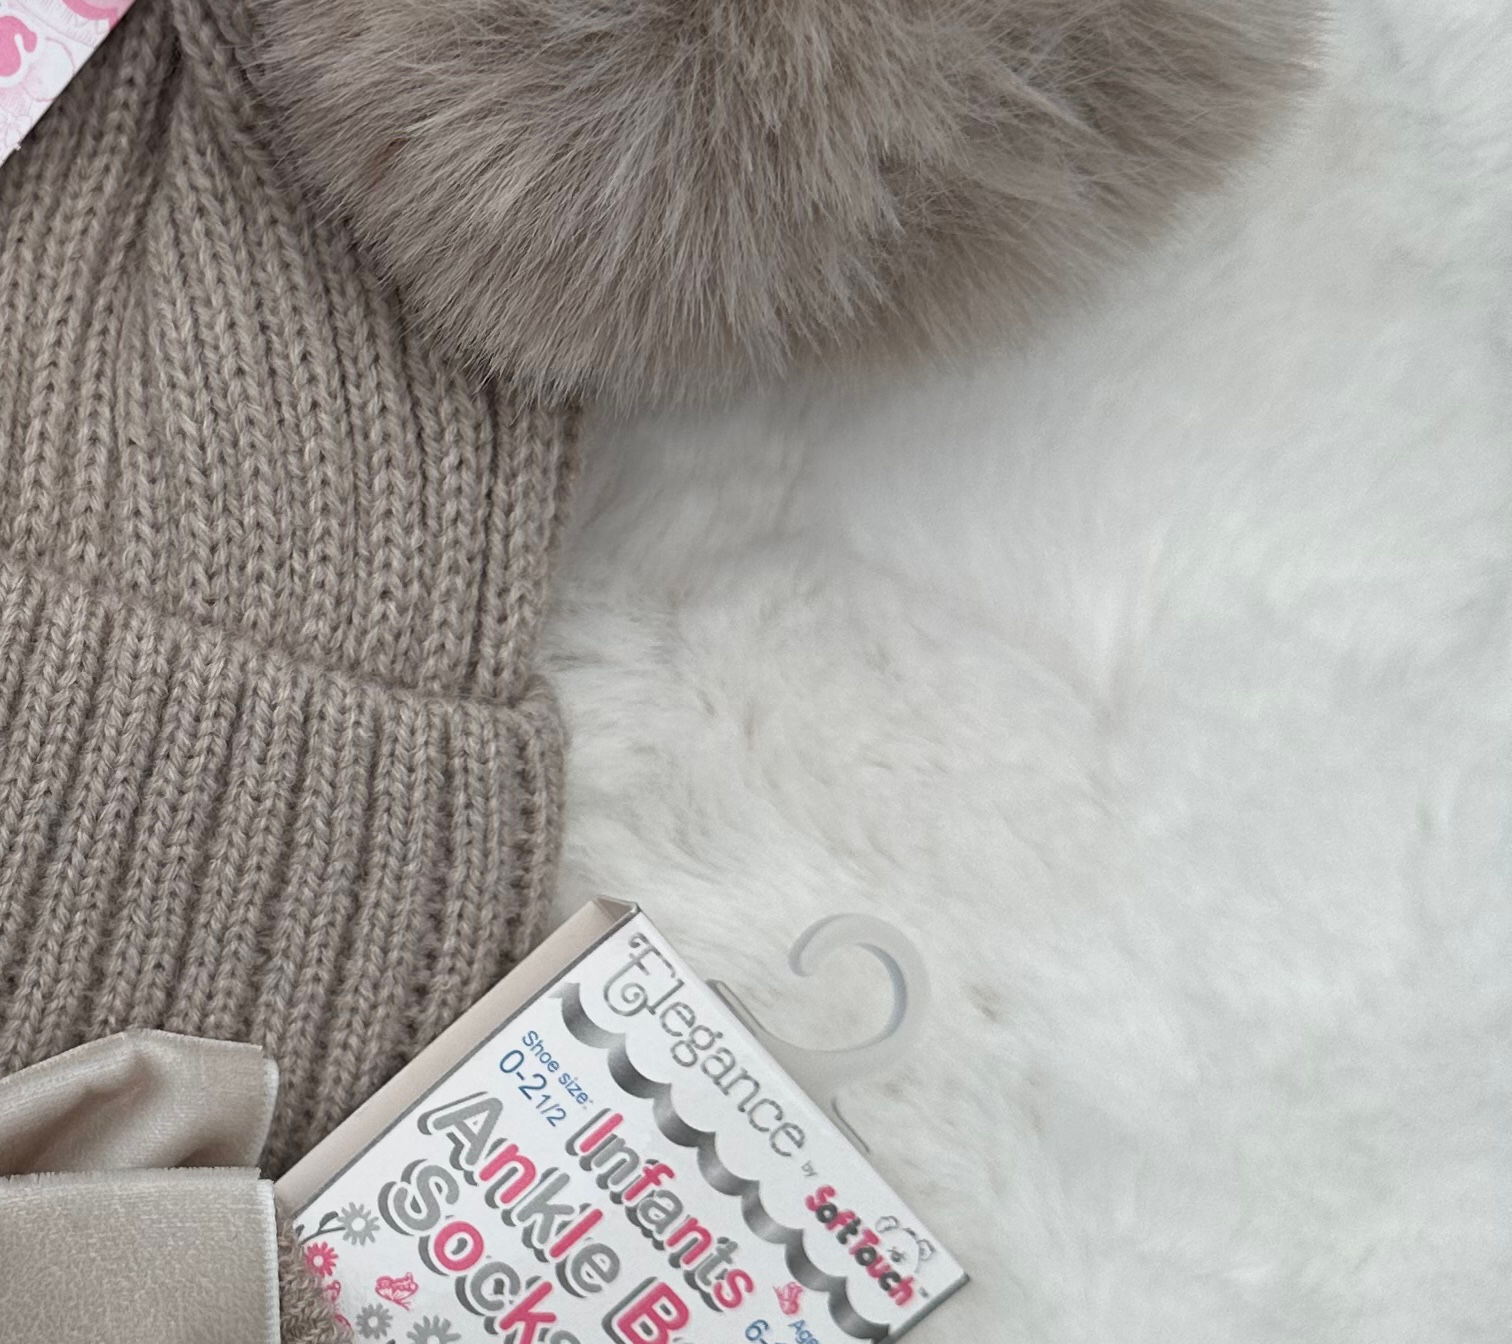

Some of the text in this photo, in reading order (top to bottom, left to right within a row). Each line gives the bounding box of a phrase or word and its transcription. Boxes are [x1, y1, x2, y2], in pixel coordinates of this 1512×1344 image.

[521, 1030, 594, 1110] Shoe size:
[602, 932, 807, 1158] Elegance
[801, 1160, 818, 1179] by
[428, 1095, 621, 1295] Ankle
[575, 1110, 755, 1310] Infants
